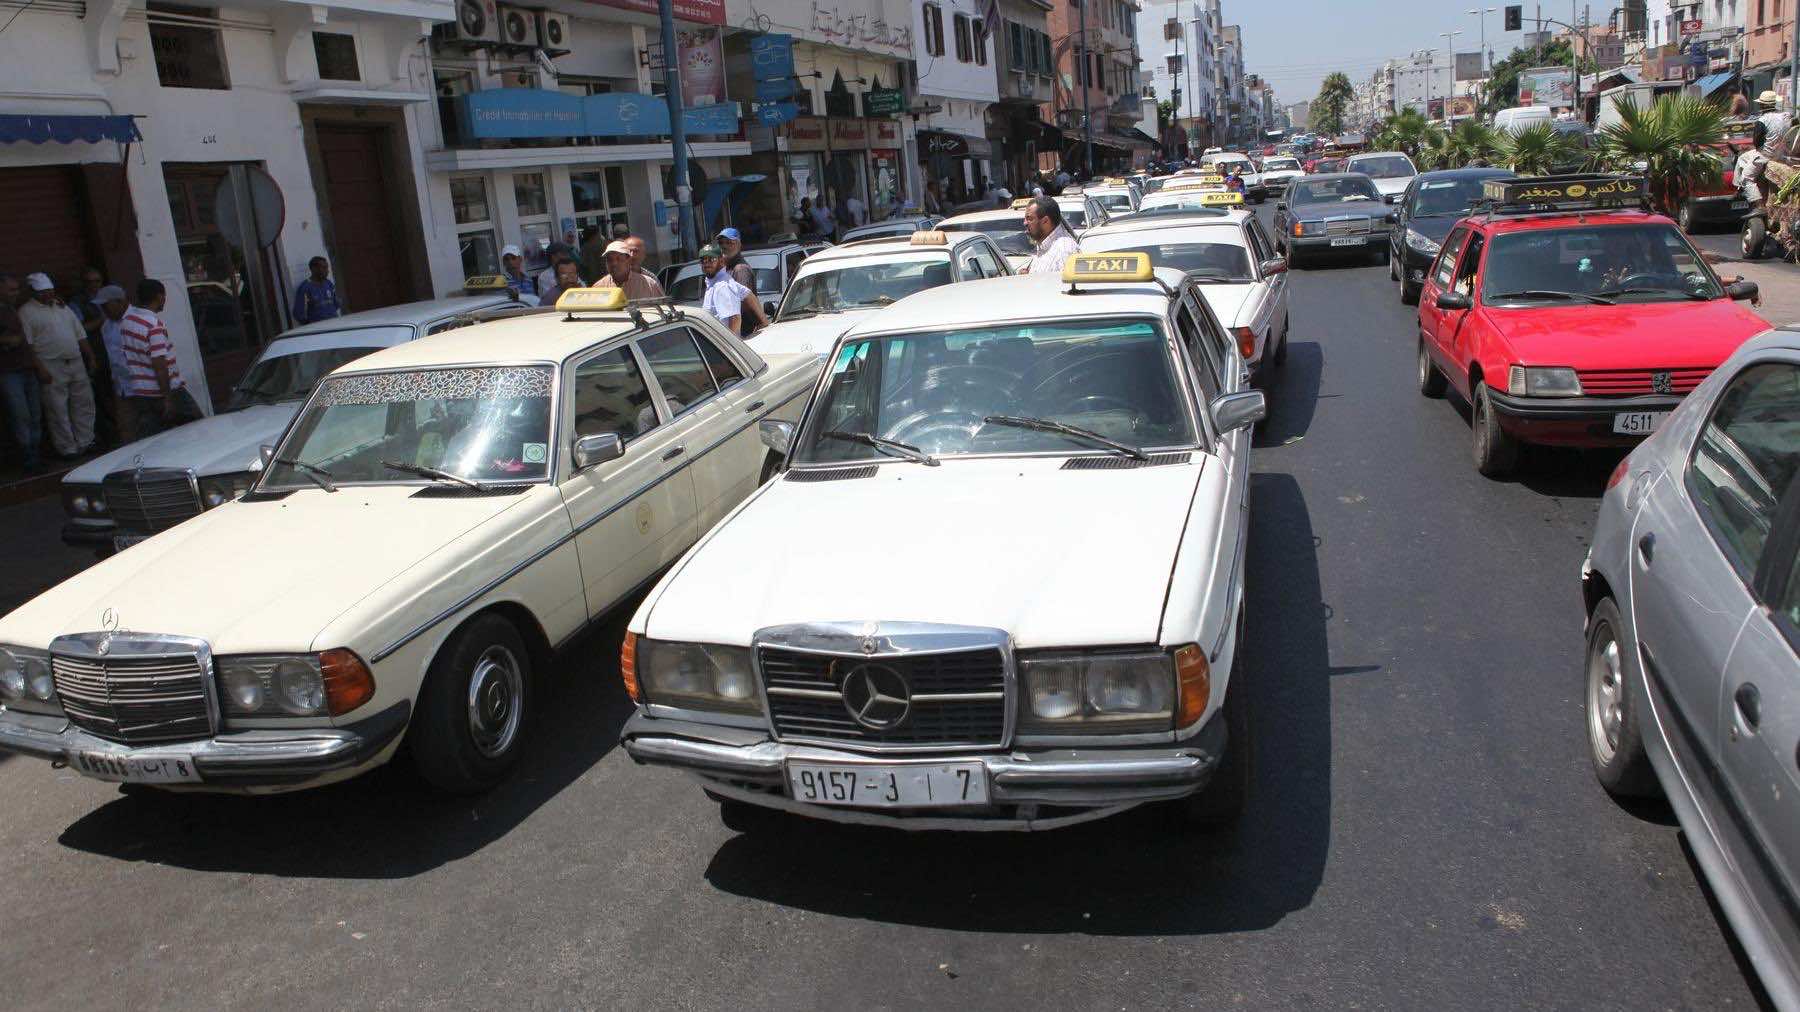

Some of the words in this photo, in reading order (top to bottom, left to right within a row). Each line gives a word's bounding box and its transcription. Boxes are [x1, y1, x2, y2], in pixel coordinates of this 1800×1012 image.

[1518, 187, 1562, 200] صغير
[1590, 180, 1635, 197] طاكسي
[1086, 260, 1128, 271] TAXI
[1622, 414, 1652, 431] 4511
[957, 769, 970, 801] 7
